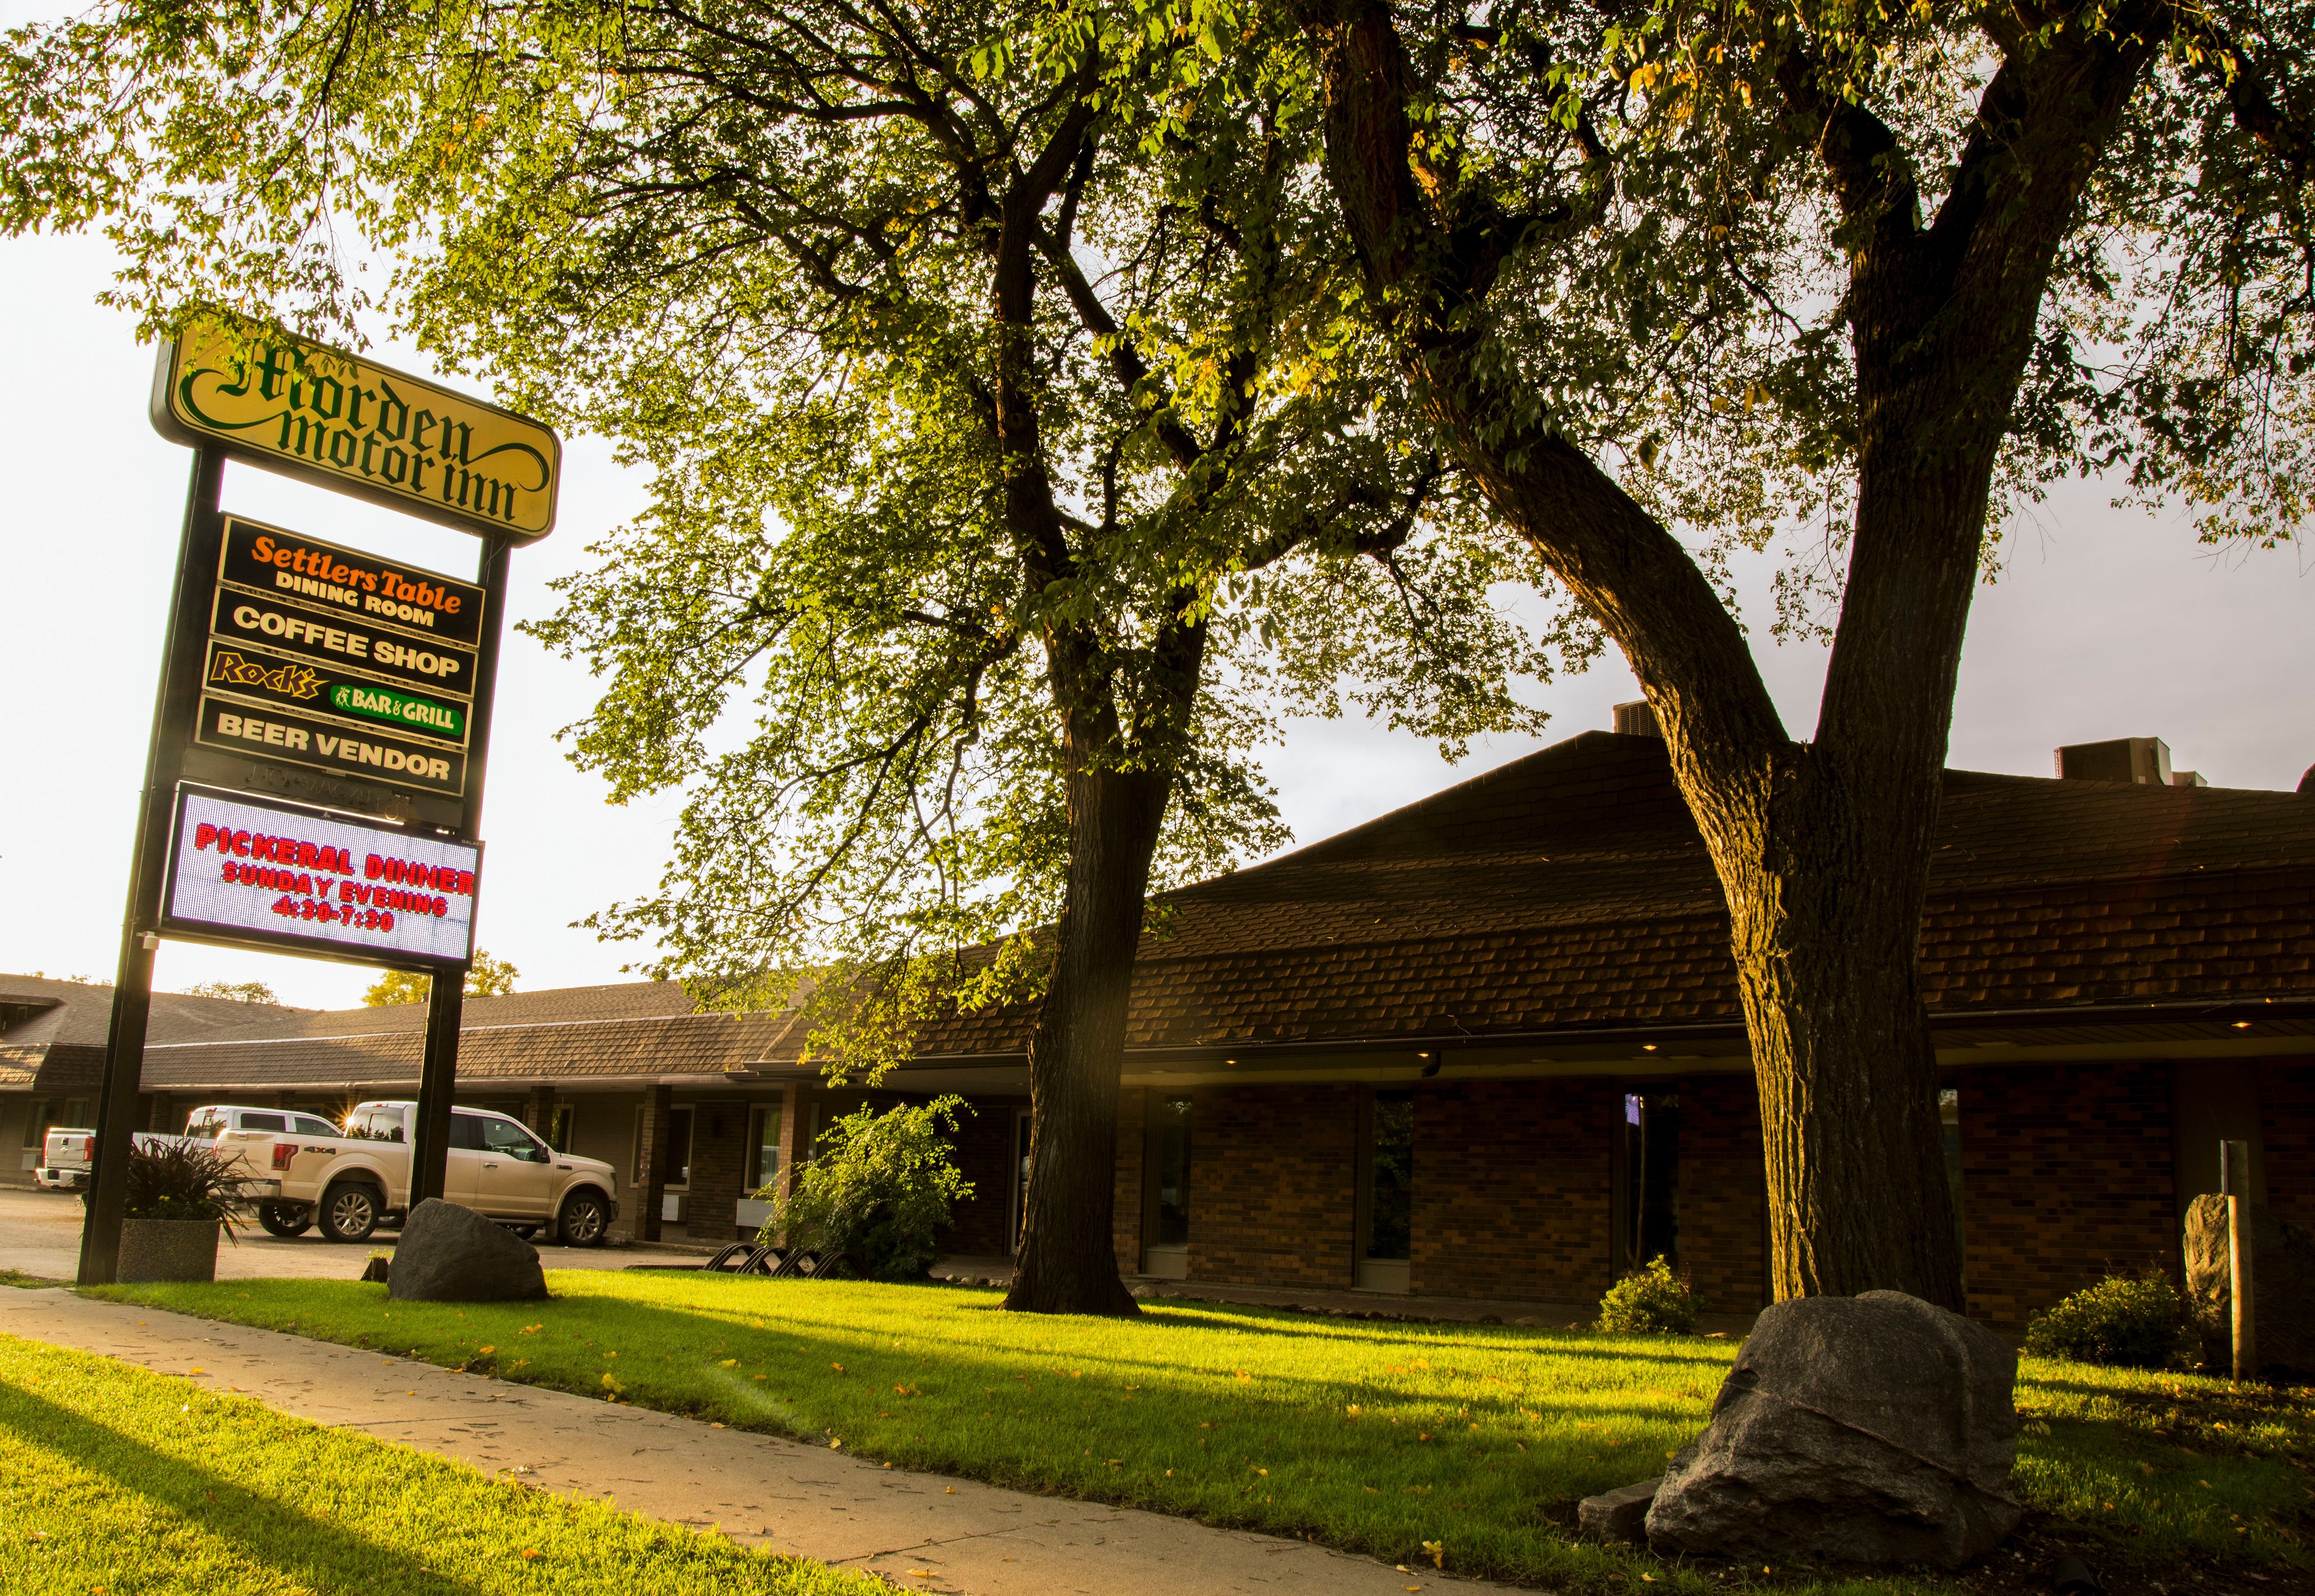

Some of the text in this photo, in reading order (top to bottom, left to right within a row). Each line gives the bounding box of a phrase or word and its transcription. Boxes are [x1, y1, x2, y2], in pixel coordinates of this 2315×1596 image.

[216, 338, 475, 466] Morden
[277, 409, 518, 522] motor inn
[251, 536, 461, 614] Settlers Table
[276, 571, 435, 627] DINING ROOM
[234, 606, 460, 677] COFFEE SHOP
[352, 688, 454, 729] BAR & GRILL
[217, 712, 450, 780] BEER VENDOR
[194, 823, 475, 897] PICKERAL DINNER
[222, 861, 448, 918] SUNDAY EVENING
[271, 894, 395, 933] 4:30-7:30
